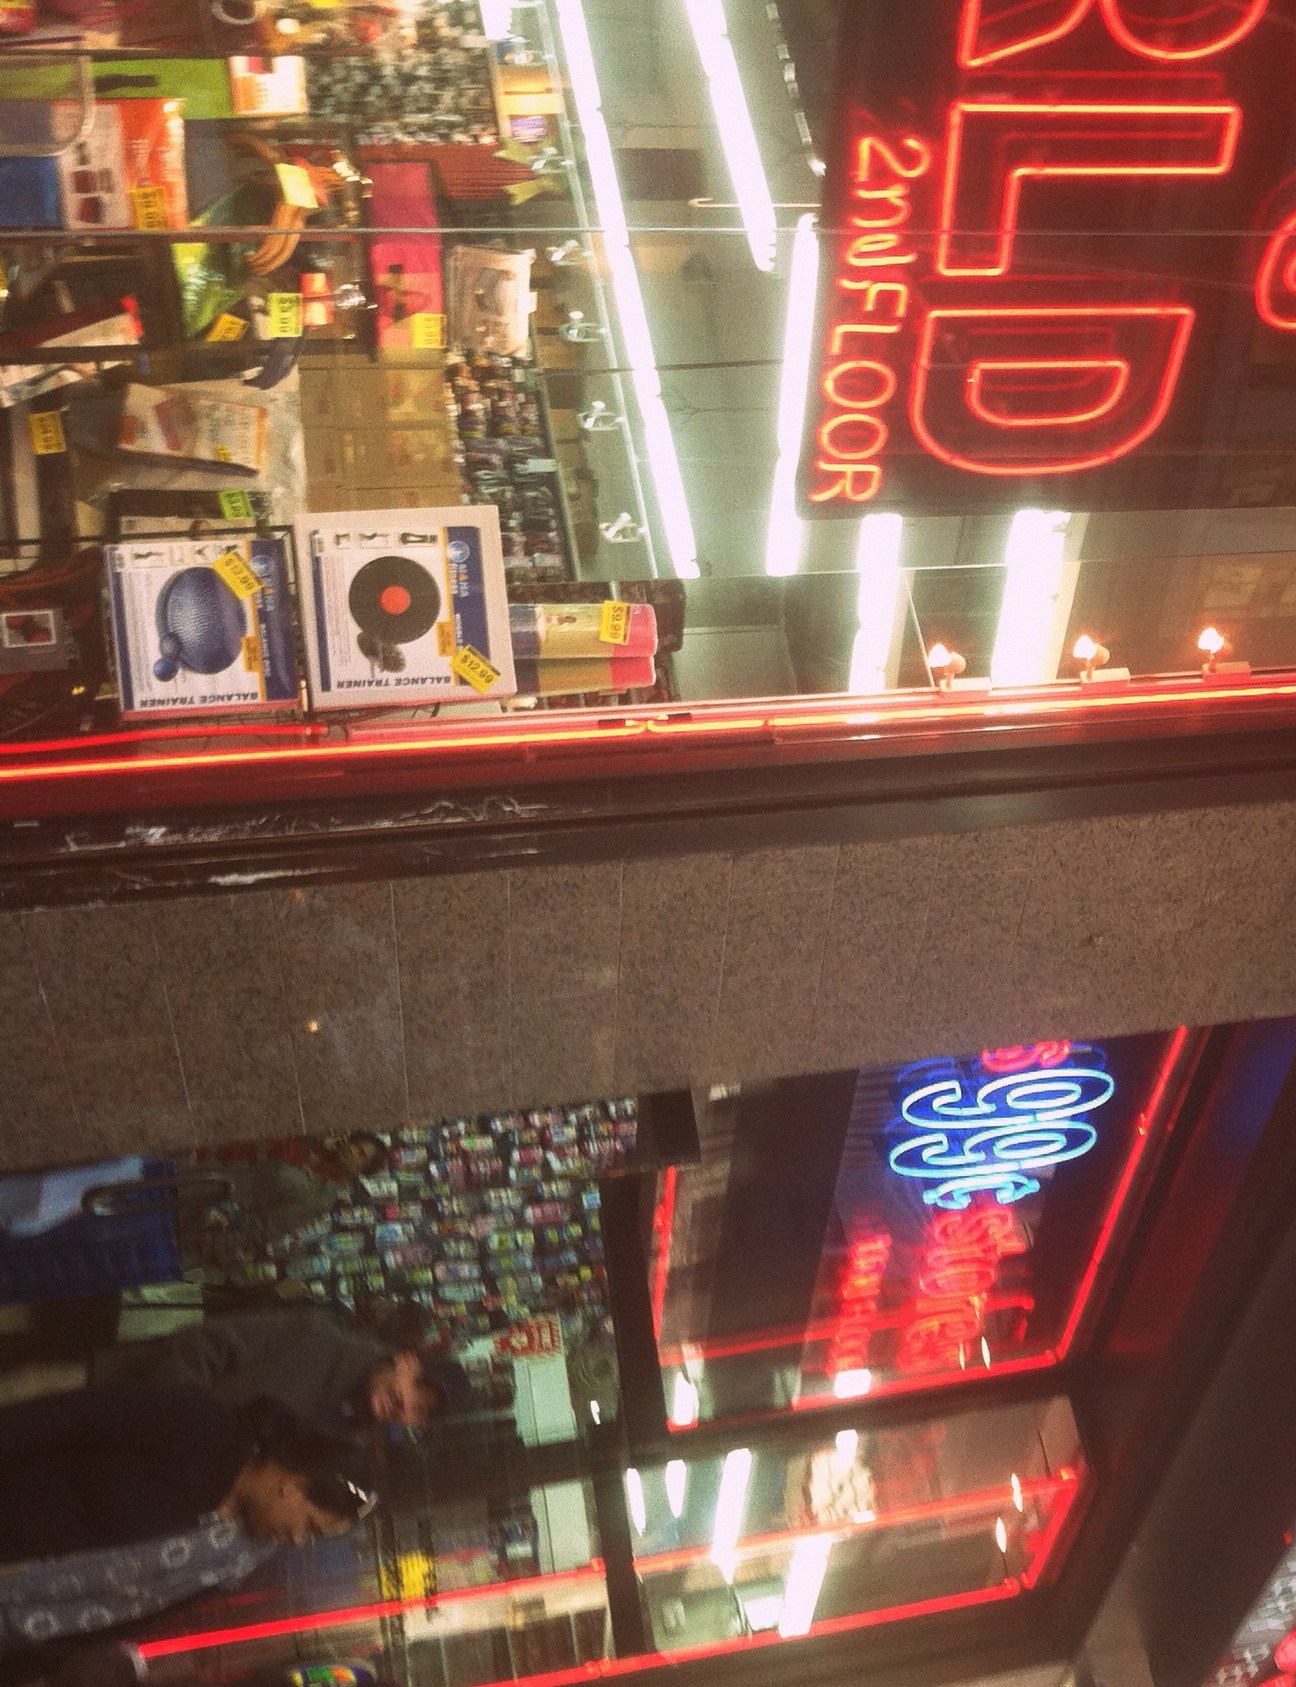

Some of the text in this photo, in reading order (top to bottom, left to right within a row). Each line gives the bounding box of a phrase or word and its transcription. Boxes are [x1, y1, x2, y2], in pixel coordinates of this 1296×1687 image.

[806, 277, 908, 502] FLOOR
[337, 676, 451, 689] BALANCE TRAINER
[140, 692, 259, 708] BALANCE TRAINER
